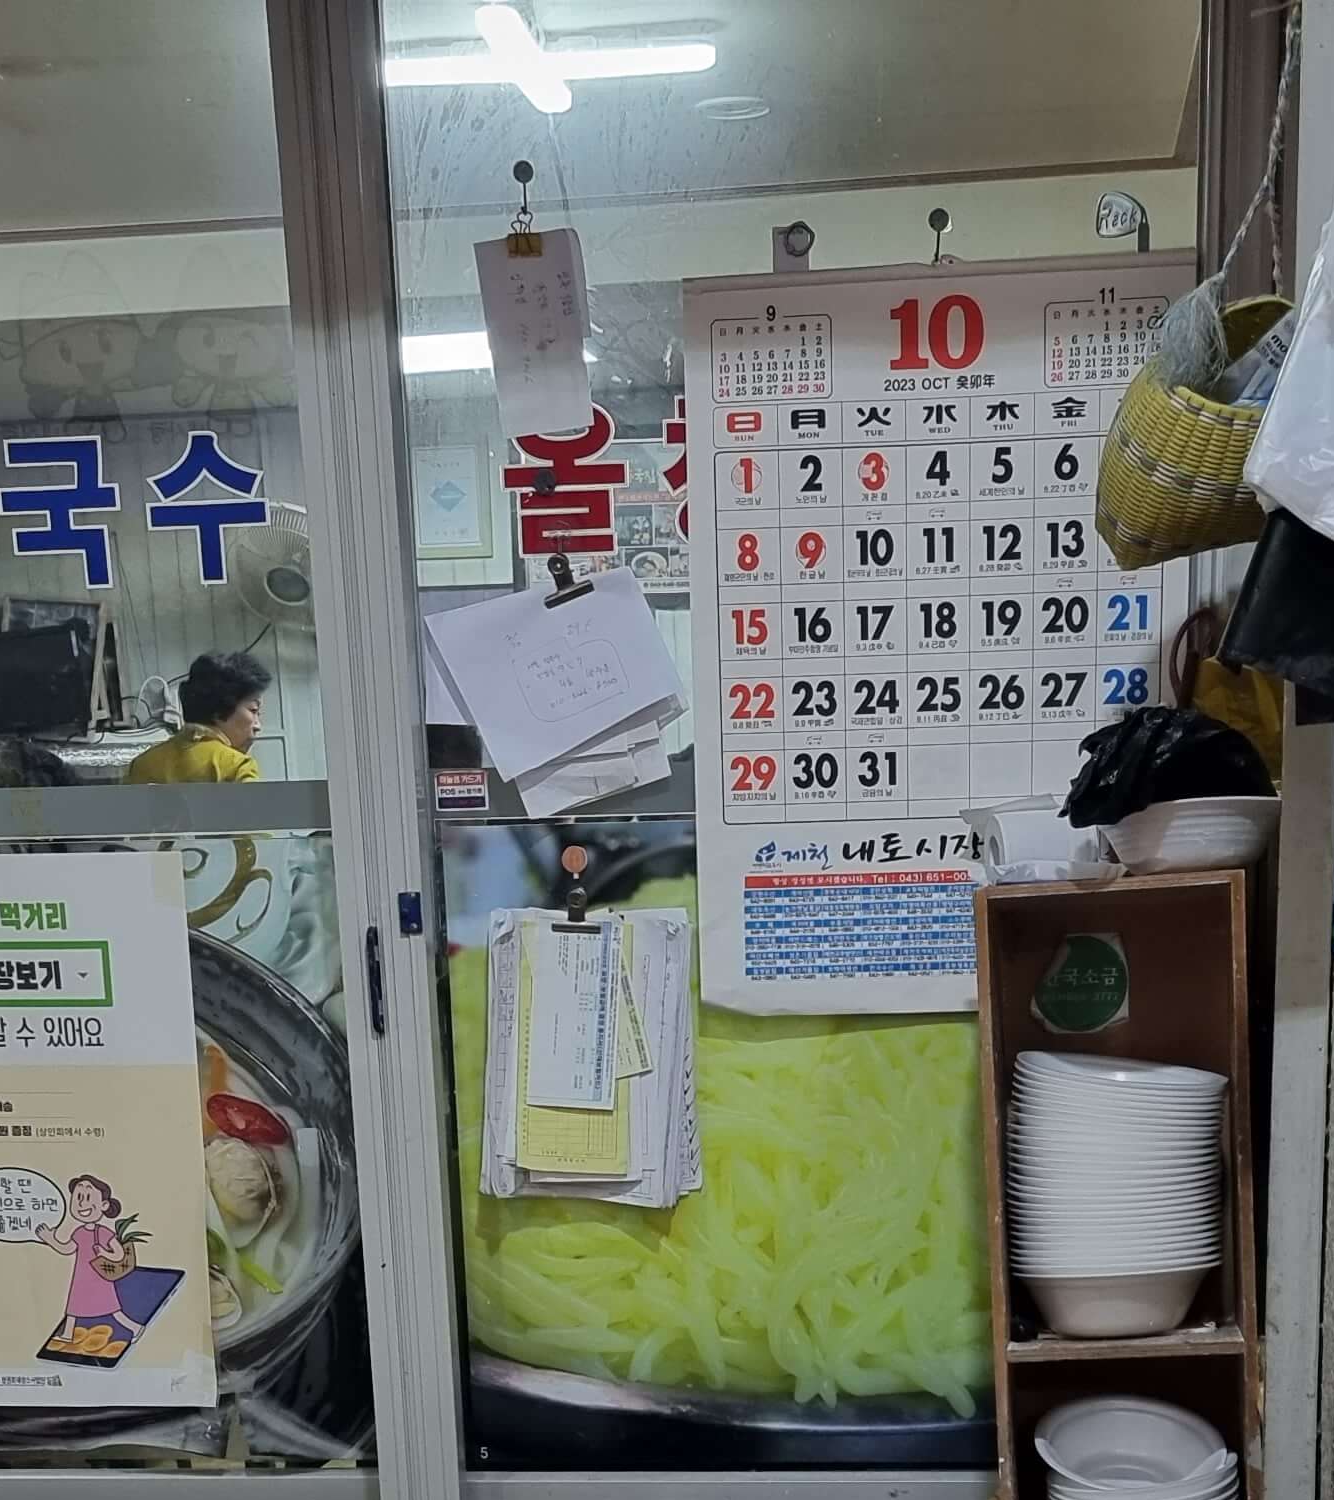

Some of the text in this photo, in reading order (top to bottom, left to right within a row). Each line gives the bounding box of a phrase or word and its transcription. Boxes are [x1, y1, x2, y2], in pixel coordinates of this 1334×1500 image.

[1099, 287, 1115, 304] 11
[766, 305, 776, 321] 9
[890, 294, 984, 370] 10
[884, 378, 916, 392] 2023
[921, 377, 951, 390] OCT
[727, 396, 1087, 433] 日 月 火 水 木 金
[740, 443, 1079, 494] 1 2 3 4 5 6
[737, 520, 1085, 572] 8 9 10 11 12 13
[731, 594, 1148, 645] 15 16 17 18 19 20 21
[729, 667, 1149, 719] 22 23 24 25 26 27 28
[730, 751, 897, 791] 29 30 31
[781, 843, 833, 871] 제천
[0, 902, 67, 930] 먹거리
[15, 1018, 36, 1048] 수
[43, 1017, 104, 1047] 있어요
[31, 1198, 58, 1212] 하면
[480, 1446, 489, 1459] 5
